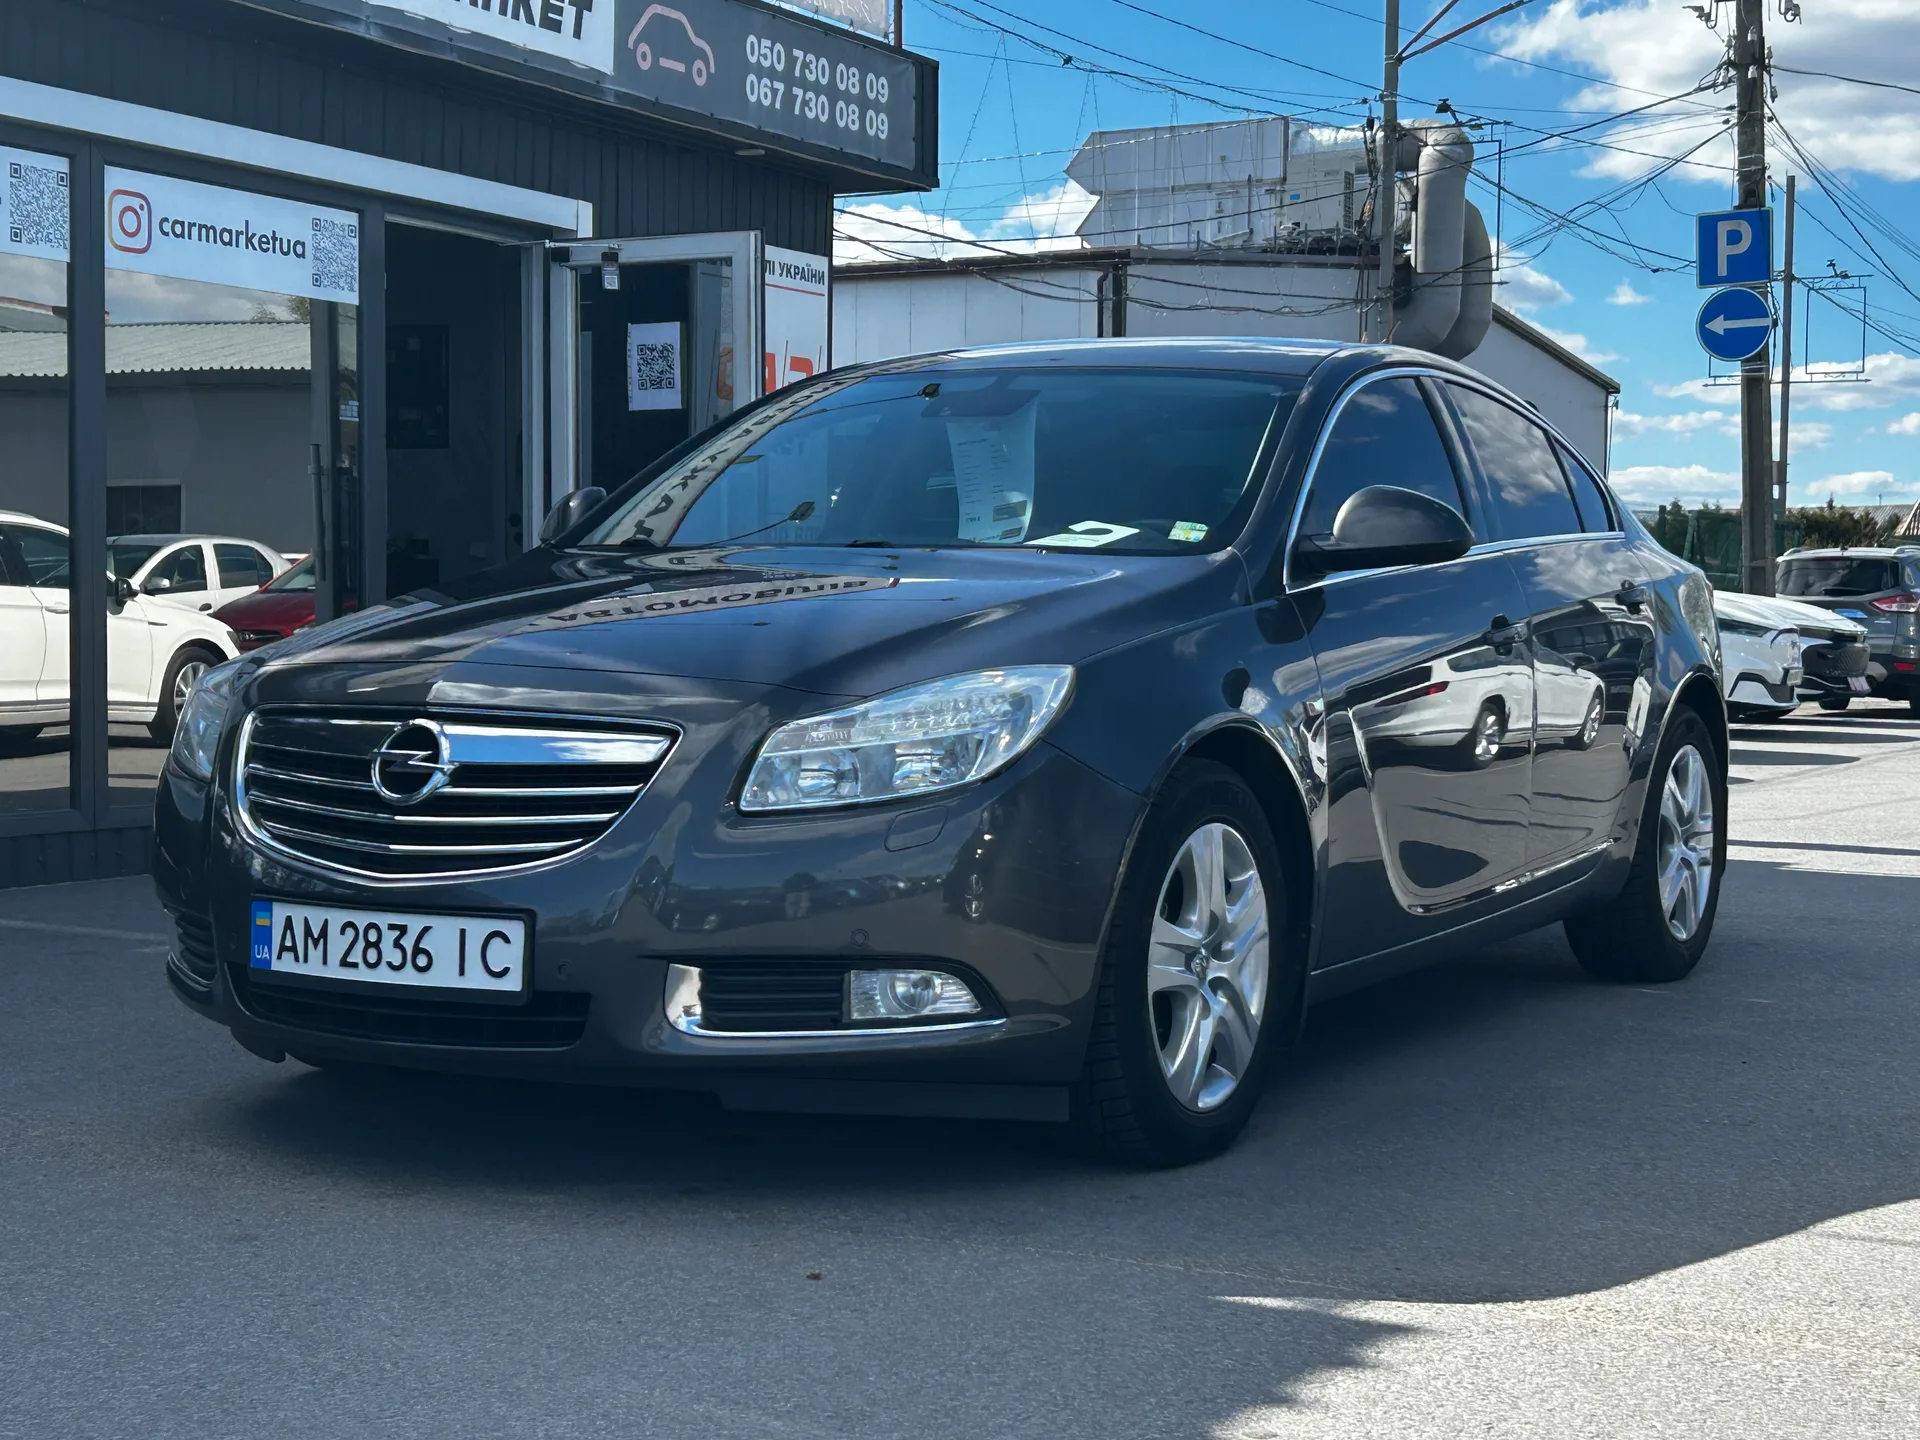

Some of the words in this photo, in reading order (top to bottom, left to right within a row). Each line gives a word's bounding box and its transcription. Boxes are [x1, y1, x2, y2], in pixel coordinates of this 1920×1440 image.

[745, 34, 785, 72] 050
[792, 48, 829, 85] 730
[836, 62, 860, 95] 08
[865, 72, 889, 104] 09
[745, 73, 785, 110] 067
[792, 86, 829, 123] 730
[835, 100, 860, 131] 08
[865, 109, 889, 140] 09
[158, 216, 306, 259] carmarketua
[1717, 219, 1752, 277] P
[778, 261, 825, 286] УКРАЇНИ
[254, 944, 270, 960] UA
[338, 920, 434, 973] 2836
